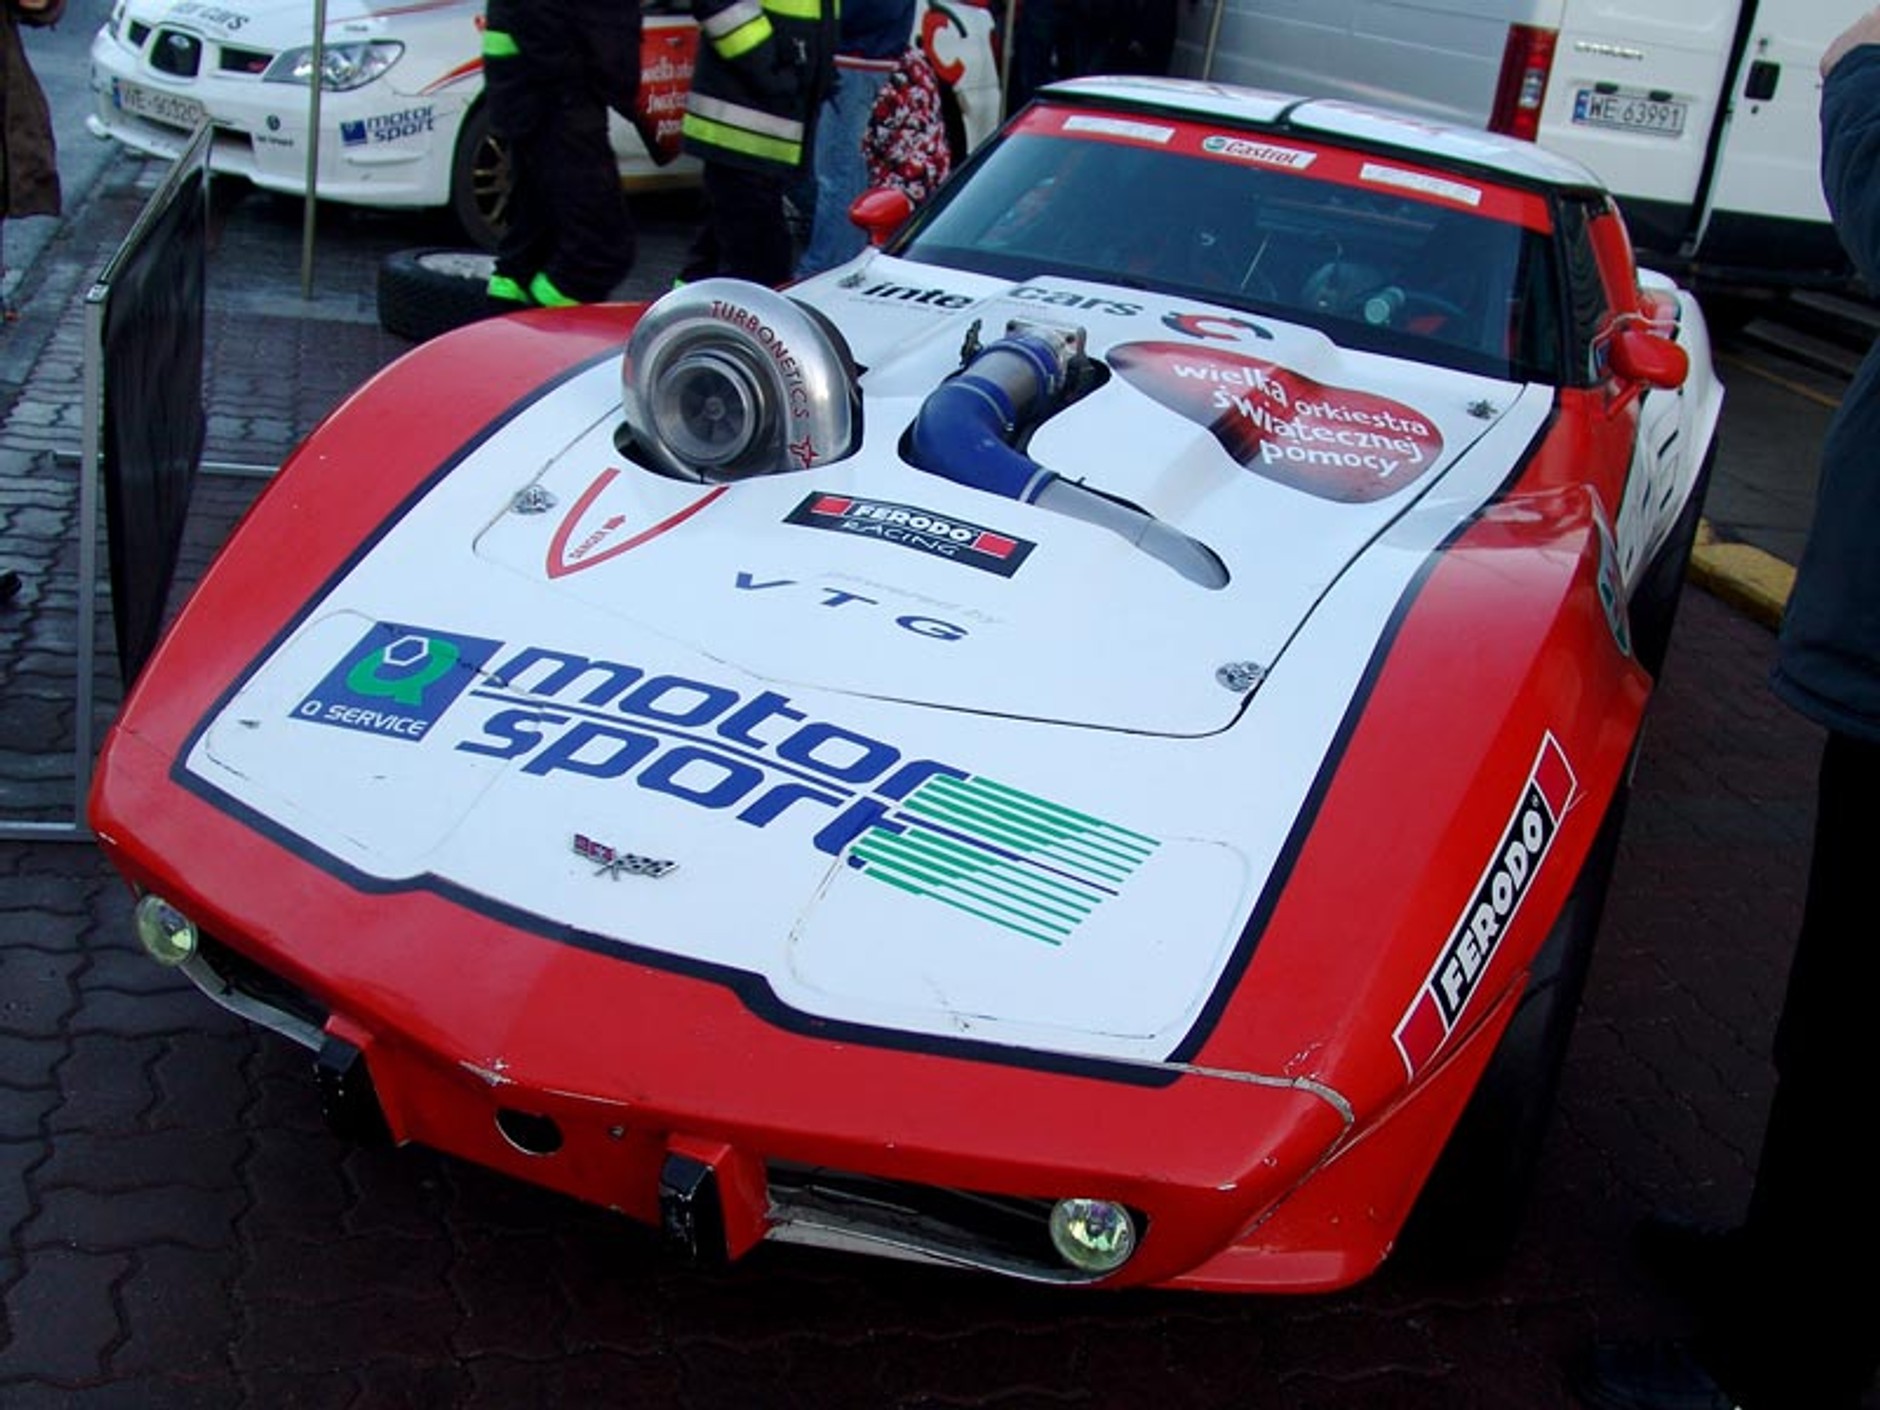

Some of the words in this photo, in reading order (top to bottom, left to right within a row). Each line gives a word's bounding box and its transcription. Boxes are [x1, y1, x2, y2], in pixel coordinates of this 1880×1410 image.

[367, 105, 435, 129] motor
[374, 115, 435, 142] sport
[1589, 96, 1618, 119] WE
[1623, 101, 1679, 128] 63991
[1224, 140, 1299, 166] Castrol
[1008, 284, 1144, 317] cars
[710, 300, 810, 419] TURBONETICS
[1293, 399, 1430, 437] orkiestra
[1259, 438, 1399, 478] pomocy
[839, 520, 960, 556] RACING
[853, 504, 972, 542] FERODO
[324, 704, 430, 737] SERVICE
[481, 646, 972, 802] motor
[454, 708, 907, 869] sport
[1440, 808, 1544, 1013] FERODO
